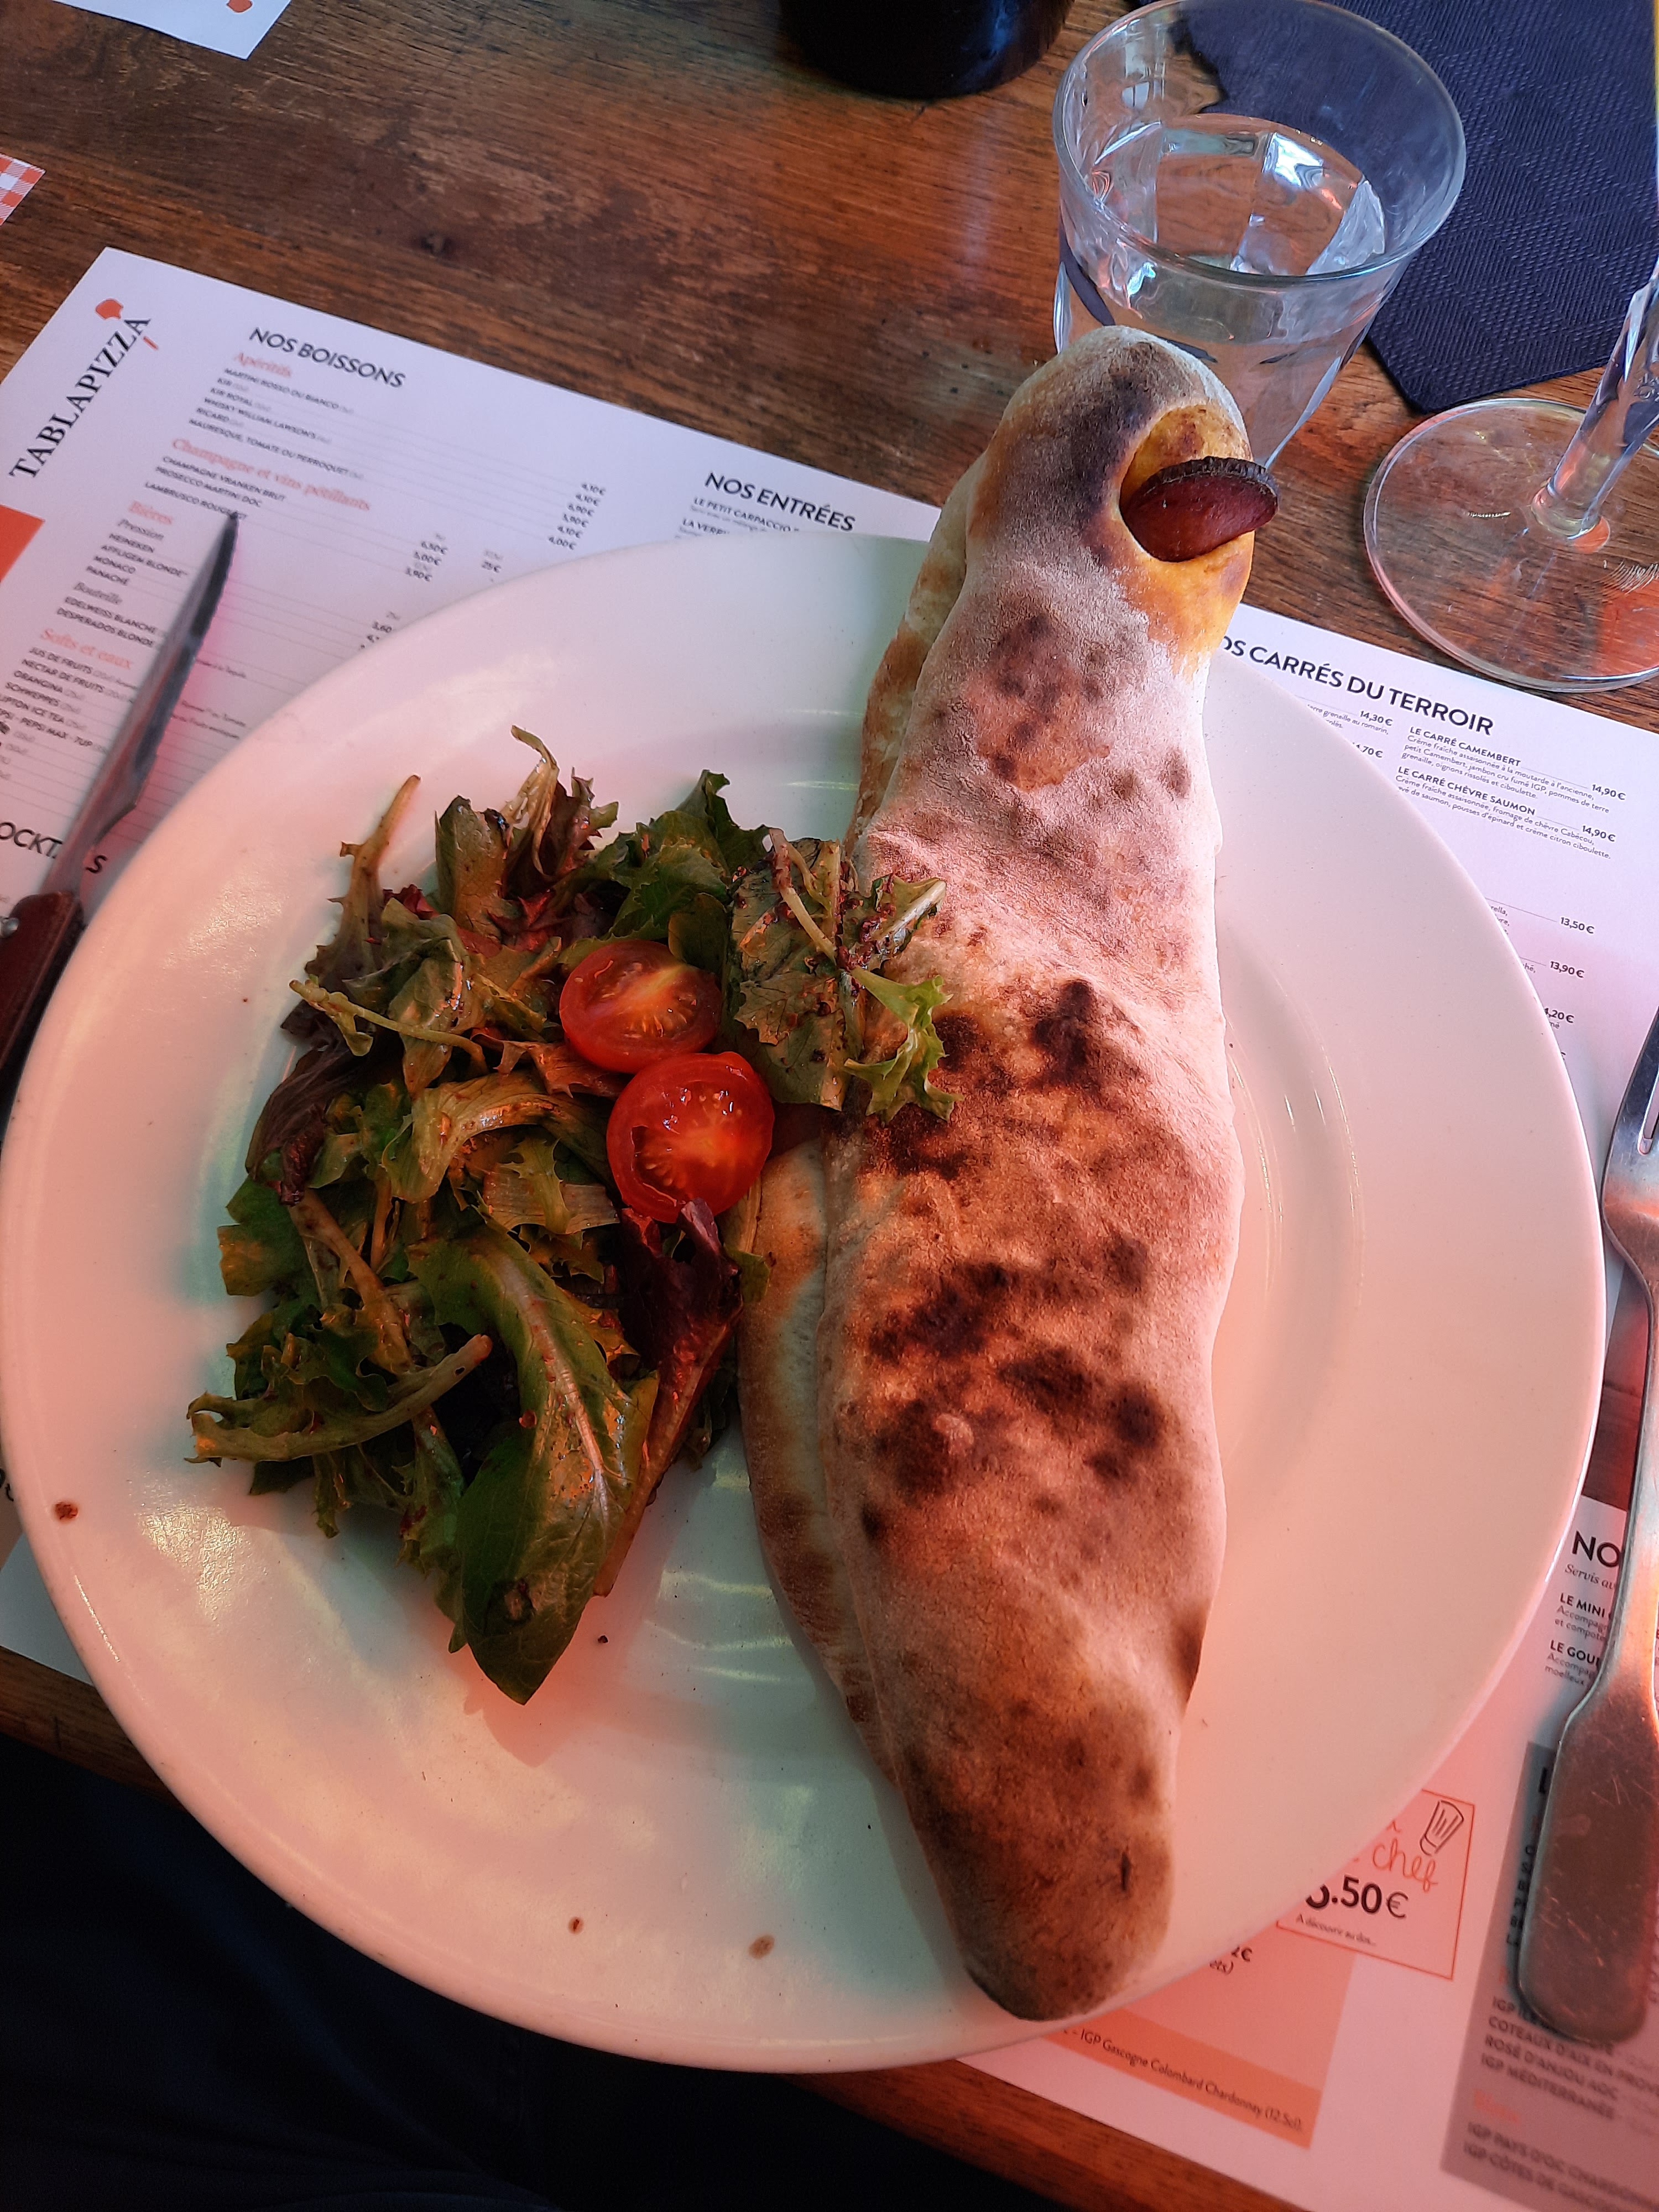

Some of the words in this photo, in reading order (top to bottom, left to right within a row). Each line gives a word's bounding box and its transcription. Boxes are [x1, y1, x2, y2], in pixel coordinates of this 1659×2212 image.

[249, 327, 298, 353] NOS
[298, 343, 407, 388] BOISSONS
[8, 319, 151, 477] TABLAPIZZA
[195, 407, 229, 422] RICARD
[163, 455, 217, 479] CHAMPAGNE
[705, 472, 755, 500] NOS
[757, 488, 855, 533] ENTRÉES
[707, 501, 732, 515] PETIT
[93, 555, 136, 574] MONACO
[21, 659, 59, 675] NECTAR
[59, 672, 72, 681] DE
[73, 677, 105, 692] FRUITS
[29, 646, 46, 658] JUS
[47, 653, 60, 662] DE
[61, 658, 93, 674] FRUITS
[4, 682, 60, 707] SCHWEPPES
[14, 670, 63, 693] ORANGINA
[1223, 635, 1246, 656] OS
[1249, 646, 1344, 687] CARRÉS
[1347, 676, 1384, 700] DU
[1389, 688, 1494, 736] TERROIR
[1323, 710, 1351, 723] grenaille
[1361, 721, 1389, 735] romarin,
[1407, 735, 1432, 747] Crème
[1433, 743, 1458, 756] fraîche
[1459, 753, 1500, 770] assaisonnée
[1515, 770, 1549, 785] moutarde
[1551, 779, 1556, 787] à
[1410, 726, 1422, 735] LE
[1423, 731, 1457, 747] CARRÉ
[1459, 742, 1521, 766] CAMEMBERT
[1401, 752, 1434, 767] grenaille,
[1436, 761, 1463, 775] oignons
[1464, 771, 1490, 785] rissolés
[1404, 744, 1422, 754] petit
[1423, 749, 1468, 769] Camembert,
[1468, 764, 1495, 779] jambon
[1497, 773, 1509, 781] cru
[1511, 776, 1529, 788] fumé
[1531, 783, 1547, 794] IGP,
[1548, 790, 1579, 804] pommes
[1592, 803, 1610, 813] terre
[1396, 775, 1421, 788] Crème
[1422, 782, 1447, 796] fraîche
[1447, 792, 1490, 812] assaisonnée,
[1493, 806, 1523, 822] fromage
[1535, 821, 1559, 833] chèvre
[1398, 766, 1410, 775] LE
[1412, 771, 1446, 786] CARRÉ
[1447, 782, 1488, 801] CHÈVRE
[1490, 795, 1535, 816] SAUMON
[1422, 791, 1451, 808] saumon,
[1452, 802, 1480, 816] pousses
[1525, 827, 1548, 838] crème
[1550, 834, 1572, 846] citron
[1572, 1531, 1622, 1568] NO
[1564, 1563, 1600, 1585] Servis
[1559, 1592, 1574, 1606] LE
[1576, 1598, 1605, 1618] MINI
[1554, 1618, 1564, 1627] et
[1550, 1639, 1564, 1653] LE
[1372, 1838, 1438, 1893] chef
[1485, 2034, 1521, 2059] ROSÉ
[1488, 2016, 1553, 2050] COTEAUX
[1080, 2028, 1102, 2045] IGP
[1102, 2038, 1149, 2067] Gascogne
[1151, 2059, 1204, 2090] Colombard
[1206, 2080, 1263, 2119] Chardonnay
